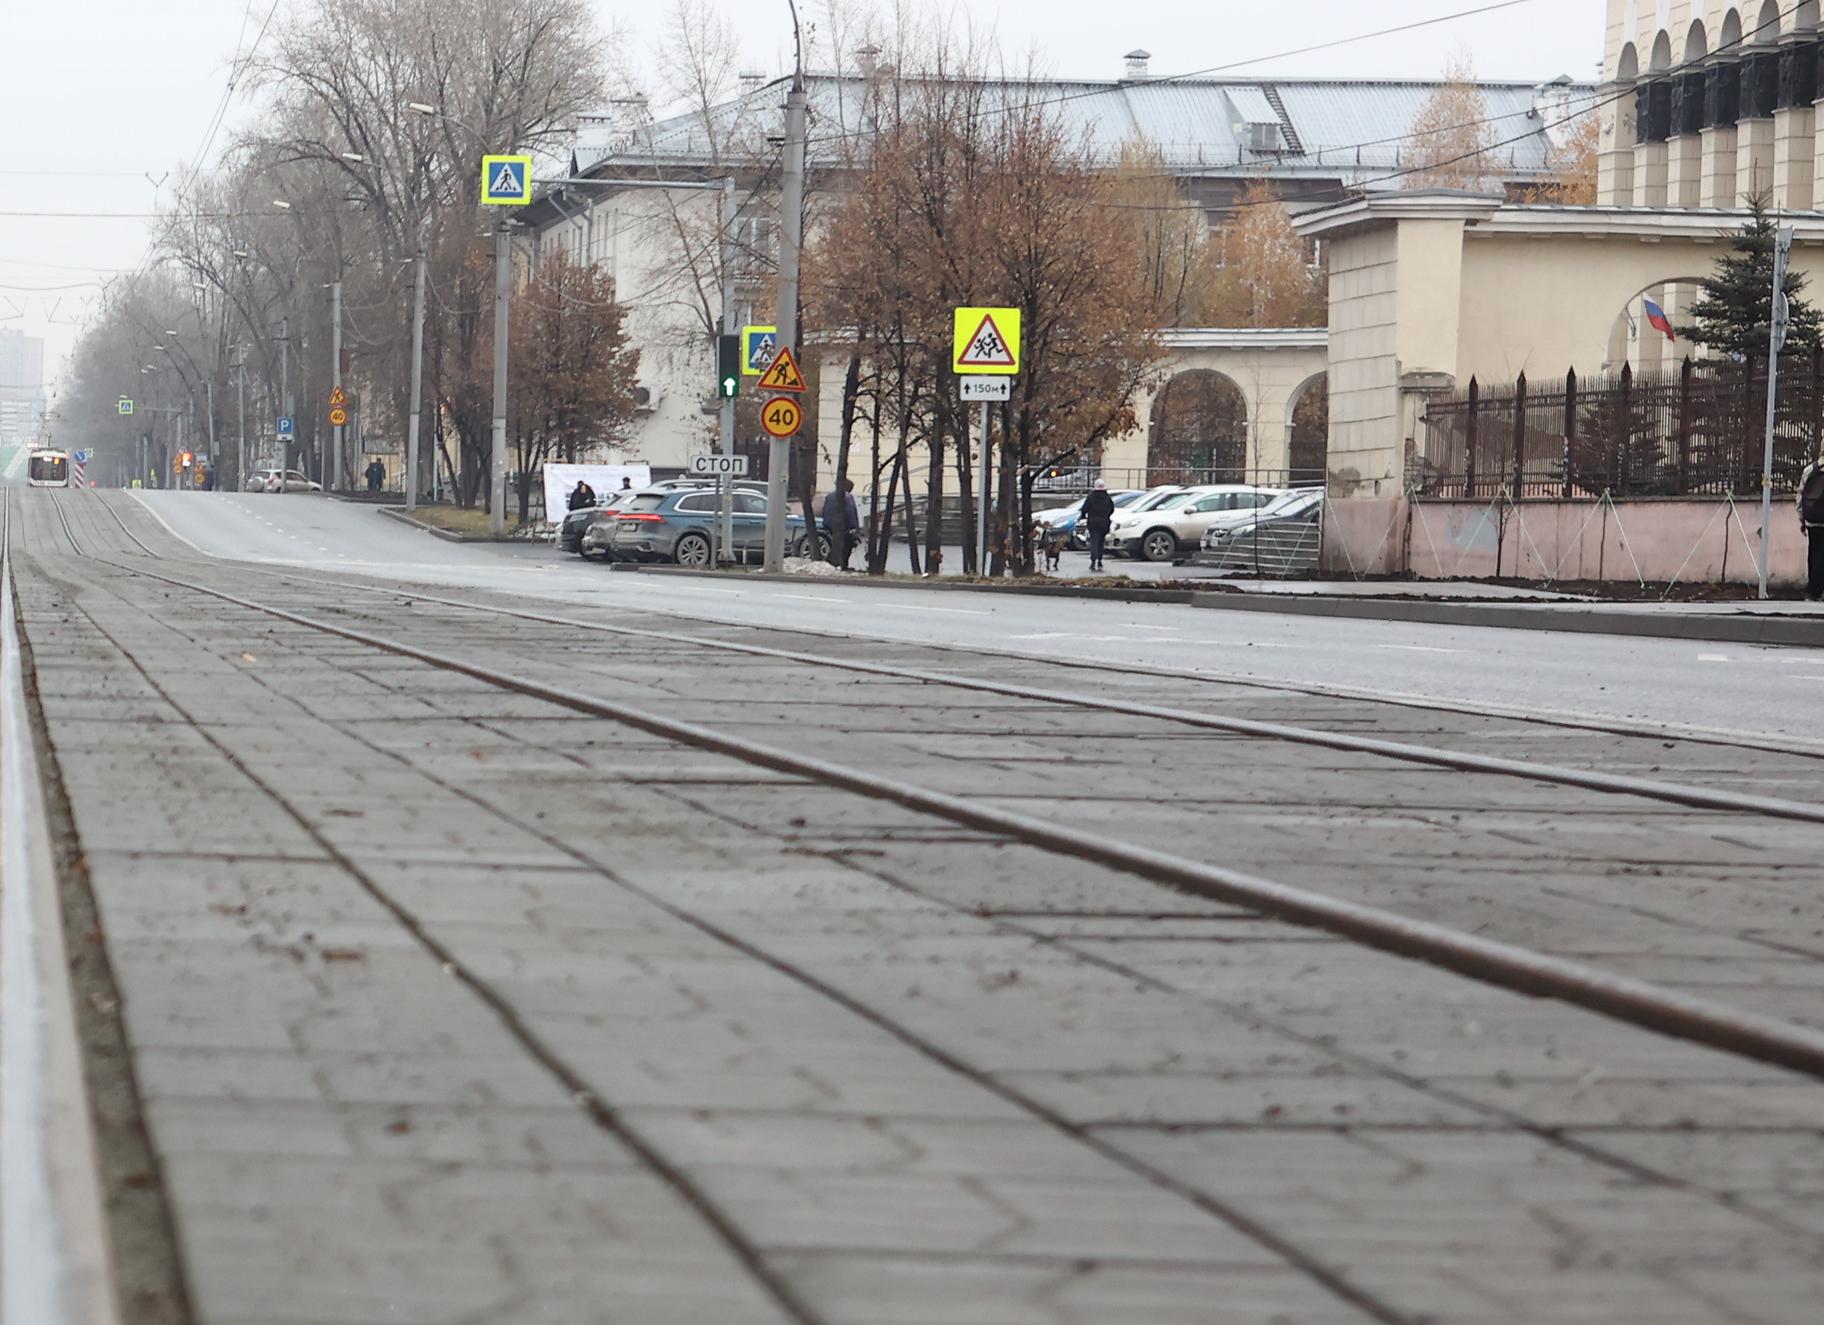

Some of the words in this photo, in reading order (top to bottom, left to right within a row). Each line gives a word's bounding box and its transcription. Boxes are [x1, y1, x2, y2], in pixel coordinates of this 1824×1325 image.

[974, 384, 999, 393] 150м
[769, 409, 794, 426] 40
[696, 457, 743, 472] СТОП
